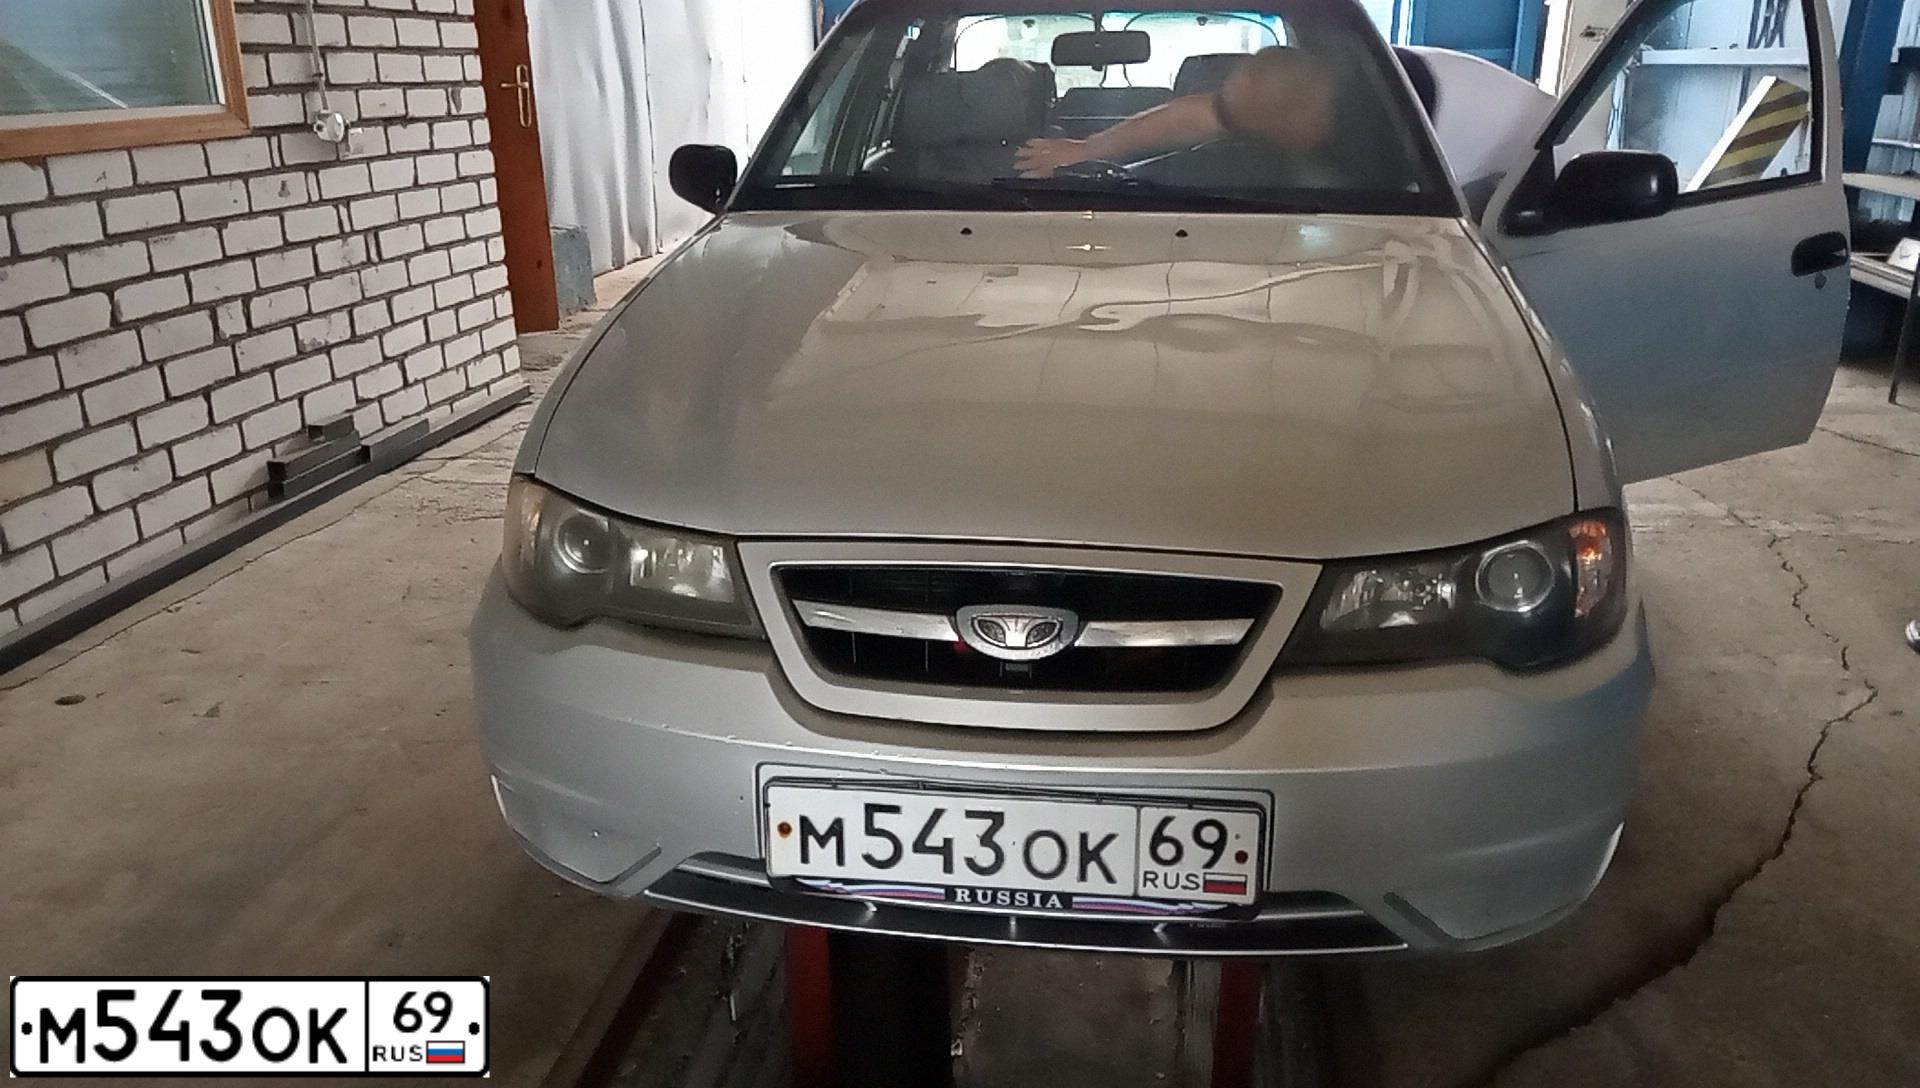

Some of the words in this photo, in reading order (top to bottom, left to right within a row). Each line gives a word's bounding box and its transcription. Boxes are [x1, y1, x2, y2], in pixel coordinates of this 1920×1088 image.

[1149, 815, 1228, 869] 69
[1143, 871, 1200, 892] RUS
[956, 887, 1063, 909] RUSSIA
